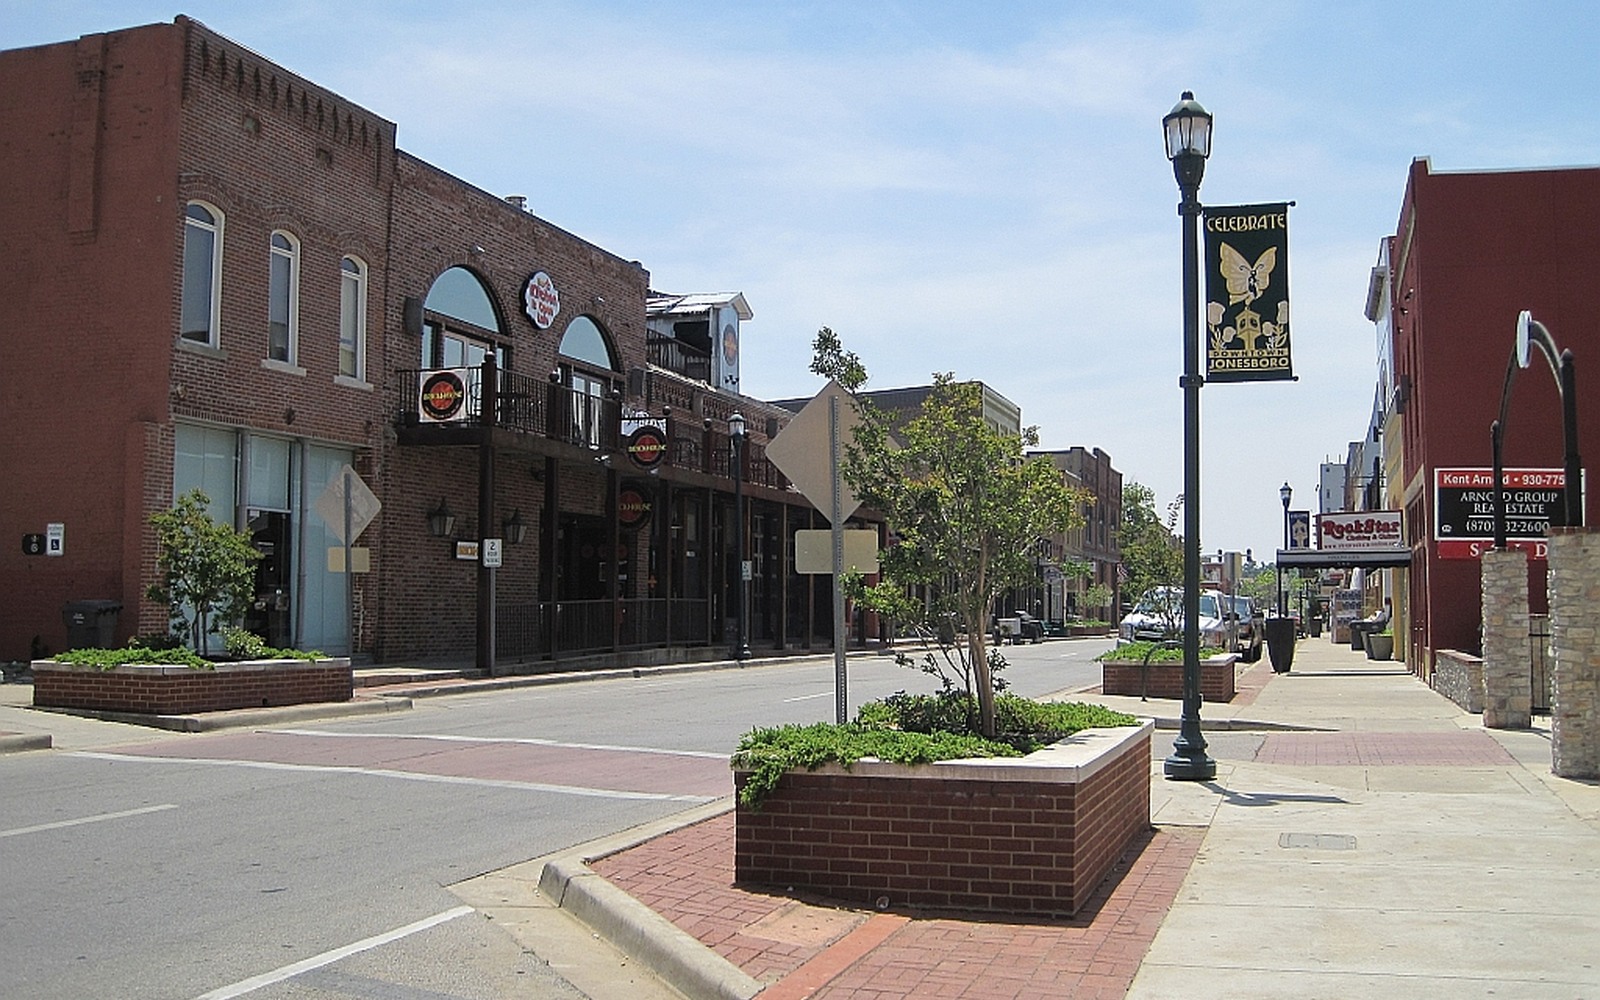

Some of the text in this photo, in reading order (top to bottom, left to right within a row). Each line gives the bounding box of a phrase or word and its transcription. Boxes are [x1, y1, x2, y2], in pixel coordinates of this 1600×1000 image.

[1206, 213, 1285, 232] CELEBRATE
[1213, 349, 1284, 357] DOWNTOWN
[1209, 357, 1289, 370] JONESBORO
[1443, 474, 1469, 485] Kent
[1472, 474, 1509, 485] Arnd
[1460, 492, 1558, 502] ARNOD GROUP
[1474, 503, 1545, 513] REA ESTATE
[490, 541, 496, 551] 2
